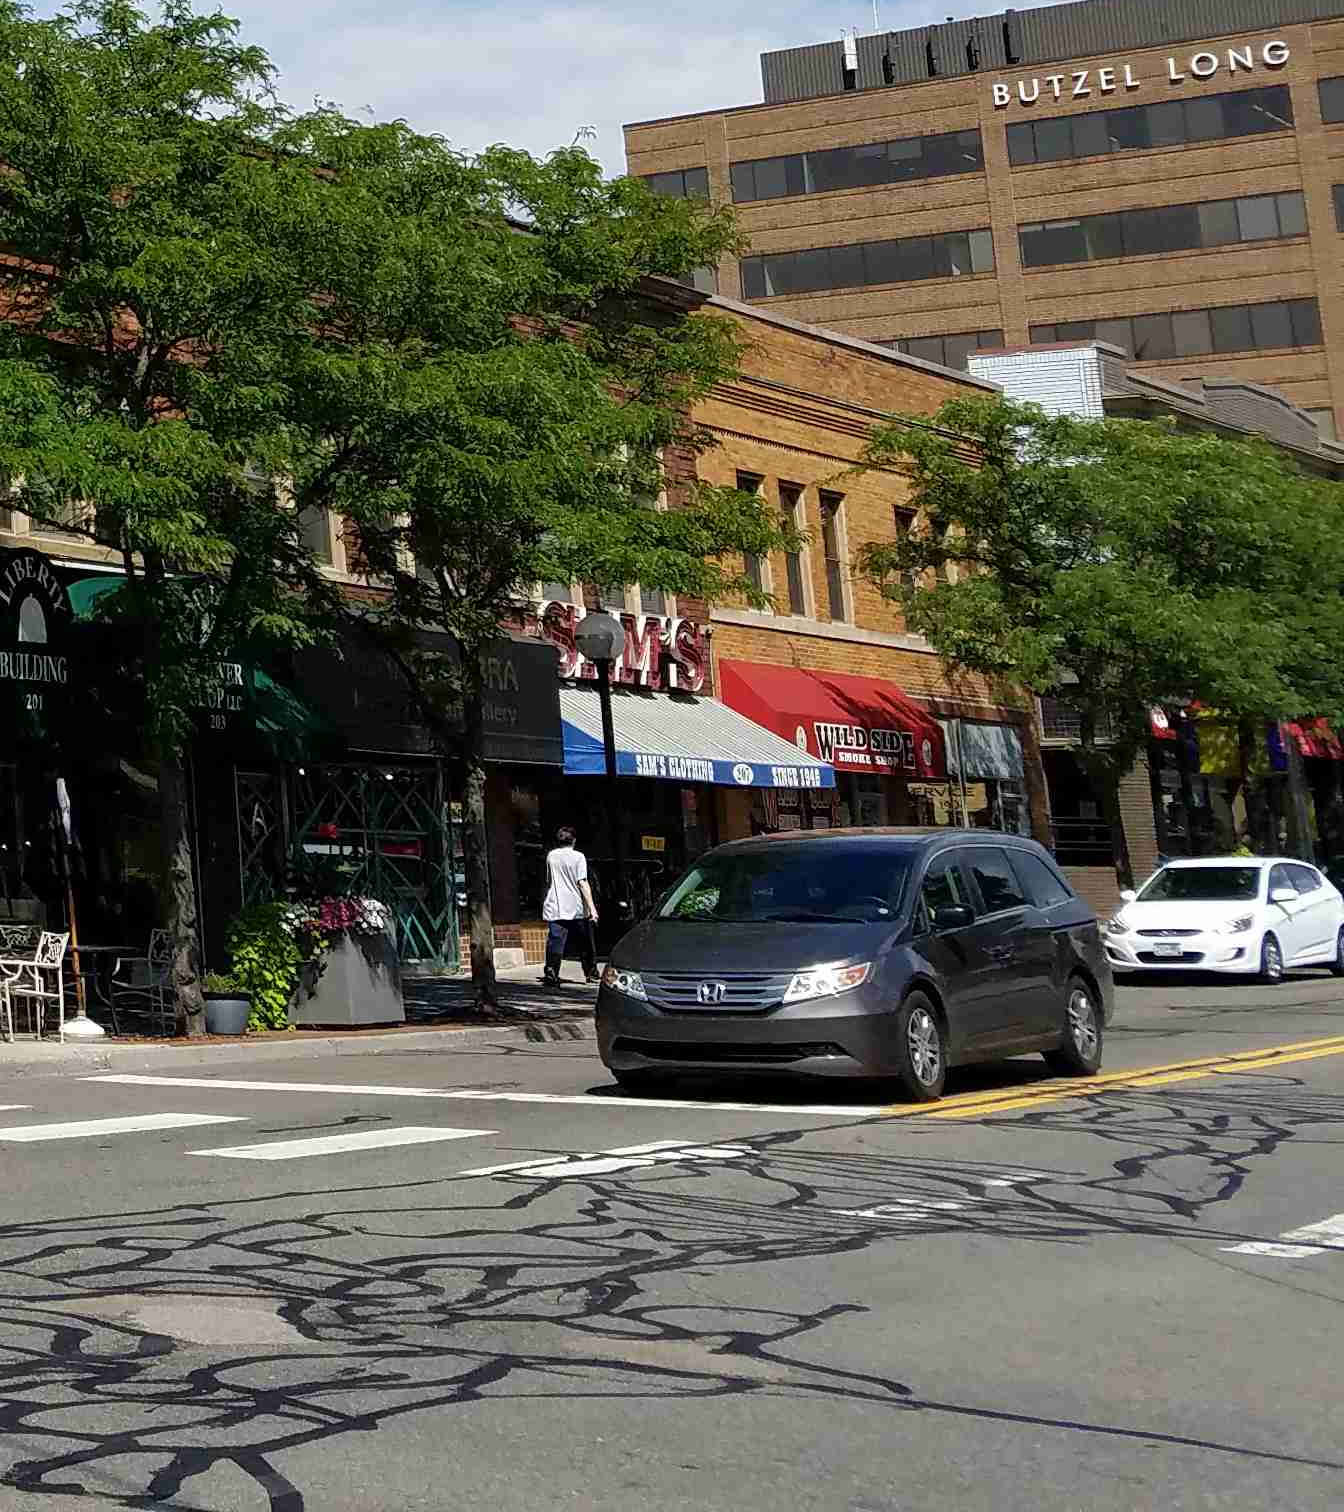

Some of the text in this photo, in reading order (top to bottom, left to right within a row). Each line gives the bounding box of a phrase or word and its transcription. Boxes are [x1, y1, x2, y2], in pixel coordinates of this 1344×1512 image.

[992, 40, 1291, 108] BUTZEL LONG
[0, 651, 69, 684] BUILDING
[26, 694, 43, 711] 201
[814, 722, 916, 769] WILD SIDE
[838, 751, 900, 767] SMOKE SHOP
[635, 754, 667, 777] SAM'S
[668, 756, 714, 782] CLOTHING
[772, 767, 799, 787] SINCE
